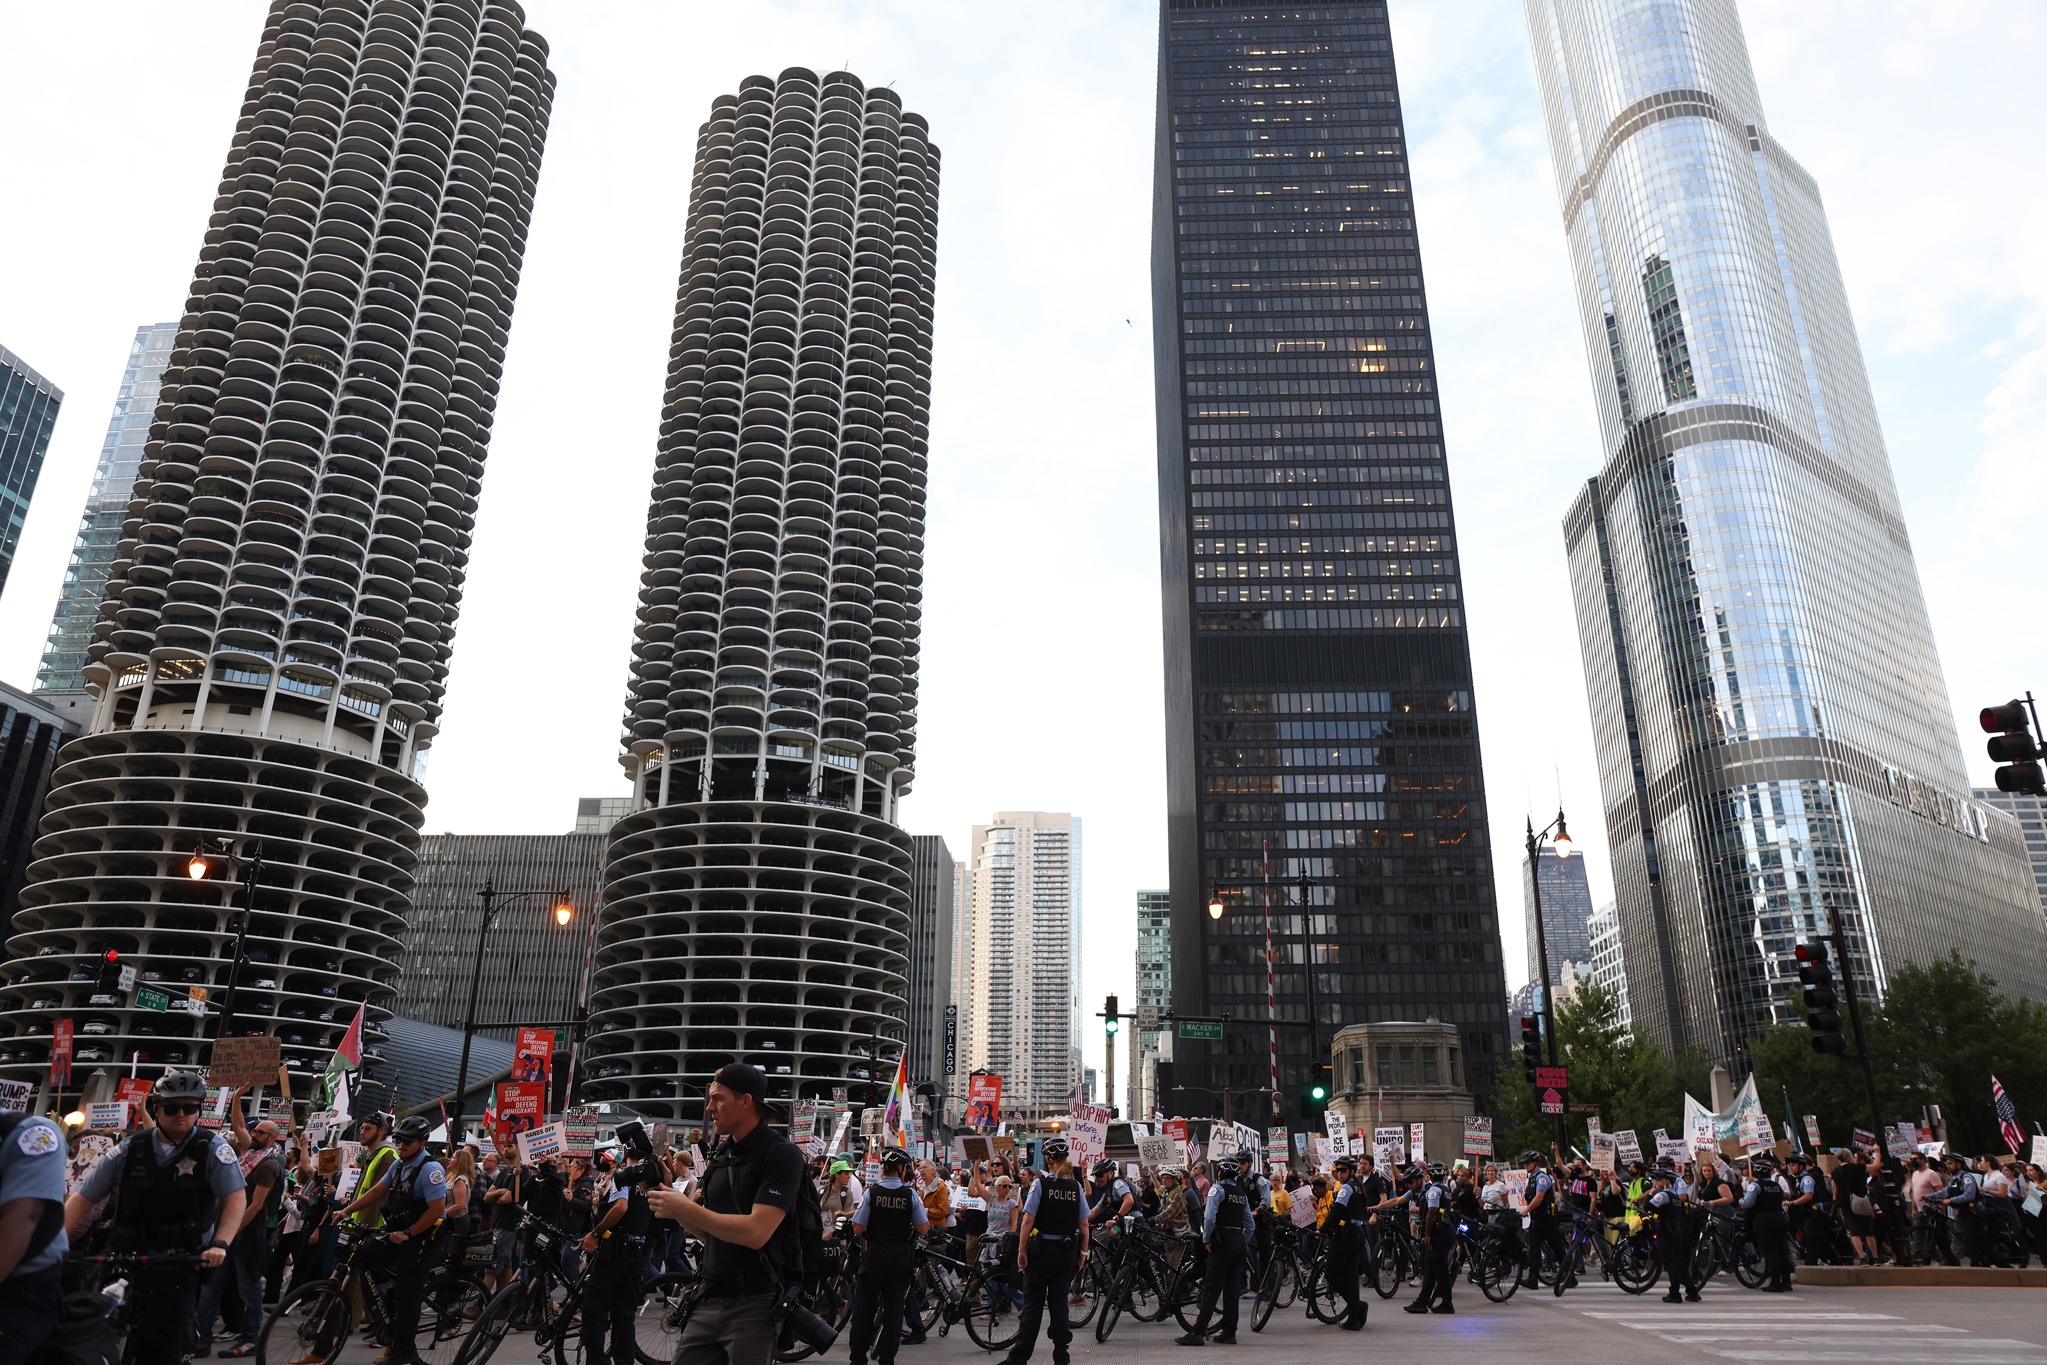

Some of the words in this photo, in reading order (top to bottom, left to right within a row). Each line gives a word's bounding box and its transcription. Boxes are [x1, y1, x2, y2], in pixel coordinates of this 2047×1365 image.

[1880, 761, 1989, 844] TRUMP
[145, 992, 160, 1003] STATE
[946, 1022, 954, 1072] CHICAGO
[1536, 1067, 1567, 1078] PUNCH
[12, 1101, 26, 1111] OFF
[1073, 1104, 1095, 1120] STOP
[1095, 1109, 1110, 1125] HIM
[1075, 1121, 1097, 1133] before
[525, 1129, 543, 1139] HANDS
[1090, 1134, 1102, 1144] it's
[1212, 1128, 1234, 1141] Abol
[1070, 1138, 1088, 1152] TOO
[1333, 1137, 1343, 1145] ICE
[529, 1146, 560, 1160] CHICAGO
[1143, 1144, 1168, 1156] BREAK
[1217, 1142, 1235, 1157] IC
[635, 1185, 647, 1196] POL
[1049, 1189, 1076, 1201] POLICE
[876, 1196, 907, 1209] POLICE
[1229, 1194, 1246, 1204] POLICE
[1300, 1198, 1308, 1210] OF
[1293, 1210, 1316, 1225] hicago
[823, 1247, 840, 1256] LICE
[364, 1270, 380, 1296] CHICAGO
[376, 1296, 388, 1318] POLICE
